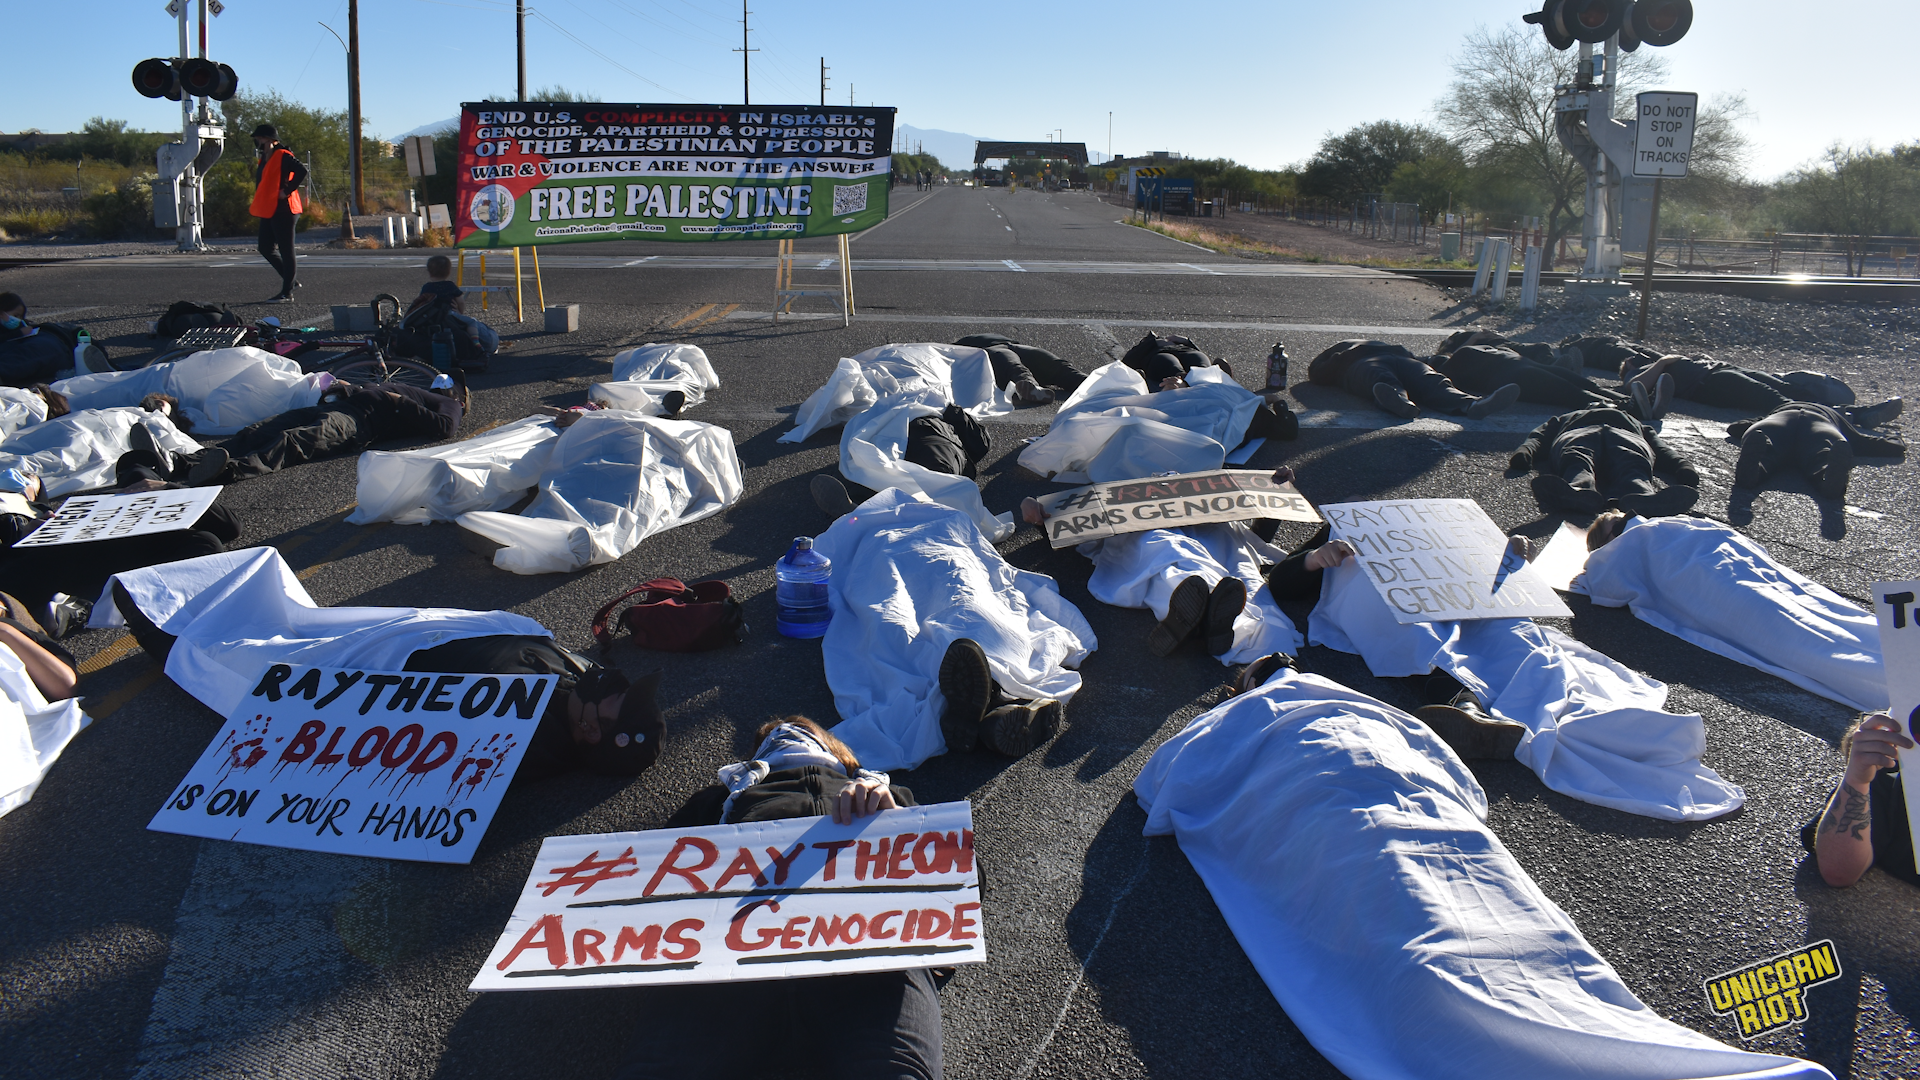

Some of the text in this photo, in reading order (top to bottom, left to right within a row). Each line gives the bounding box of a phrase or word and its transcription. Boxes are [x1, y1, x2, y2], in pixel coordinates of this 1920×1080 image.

[477, 111, 526, 125] END
[533, 111, 577, 125] U.S.
[584, 111, 732, 124] COMPLICITY
[738, 113, 764, 124] IN
[1643, 105, 1691, 118] DO NOT
[476, 125, 875, 140] GENOCIDE, APARTHEID & OPPRESSION
[1650, 120, 1682, 132] STOP
[474, 138, 875, 157] OF THE PALESTINIAN PEOPLE
[1656, 136, 1674, 148] ON
[1639, 151, 1687, 163] TRACKS
[472, 160, 875, 180] WAR & VIOLENCE ARE NOT THE ANSWER
[529, 184, 616, 222] FREE
[624, 183, 812, 219] PALESTINE
[536, 222, 803, 236] ArizonaPalestine@gmail.com www.arizonapalestine.org
[148, 500, 194, 524] GAZA
[1052, 493, 1307, 540] ARMS GENOCIDE
[1326, 502, 1486, 530] RAYTHEON
[252, 664, 548, 720] RAYTHEON
[280, 719, 459, 776] BLOOD
[167, 784, 477, 848] IS ON YOUR HANDS
[496, 899, 982, 971] ARMS GENOCIDE
